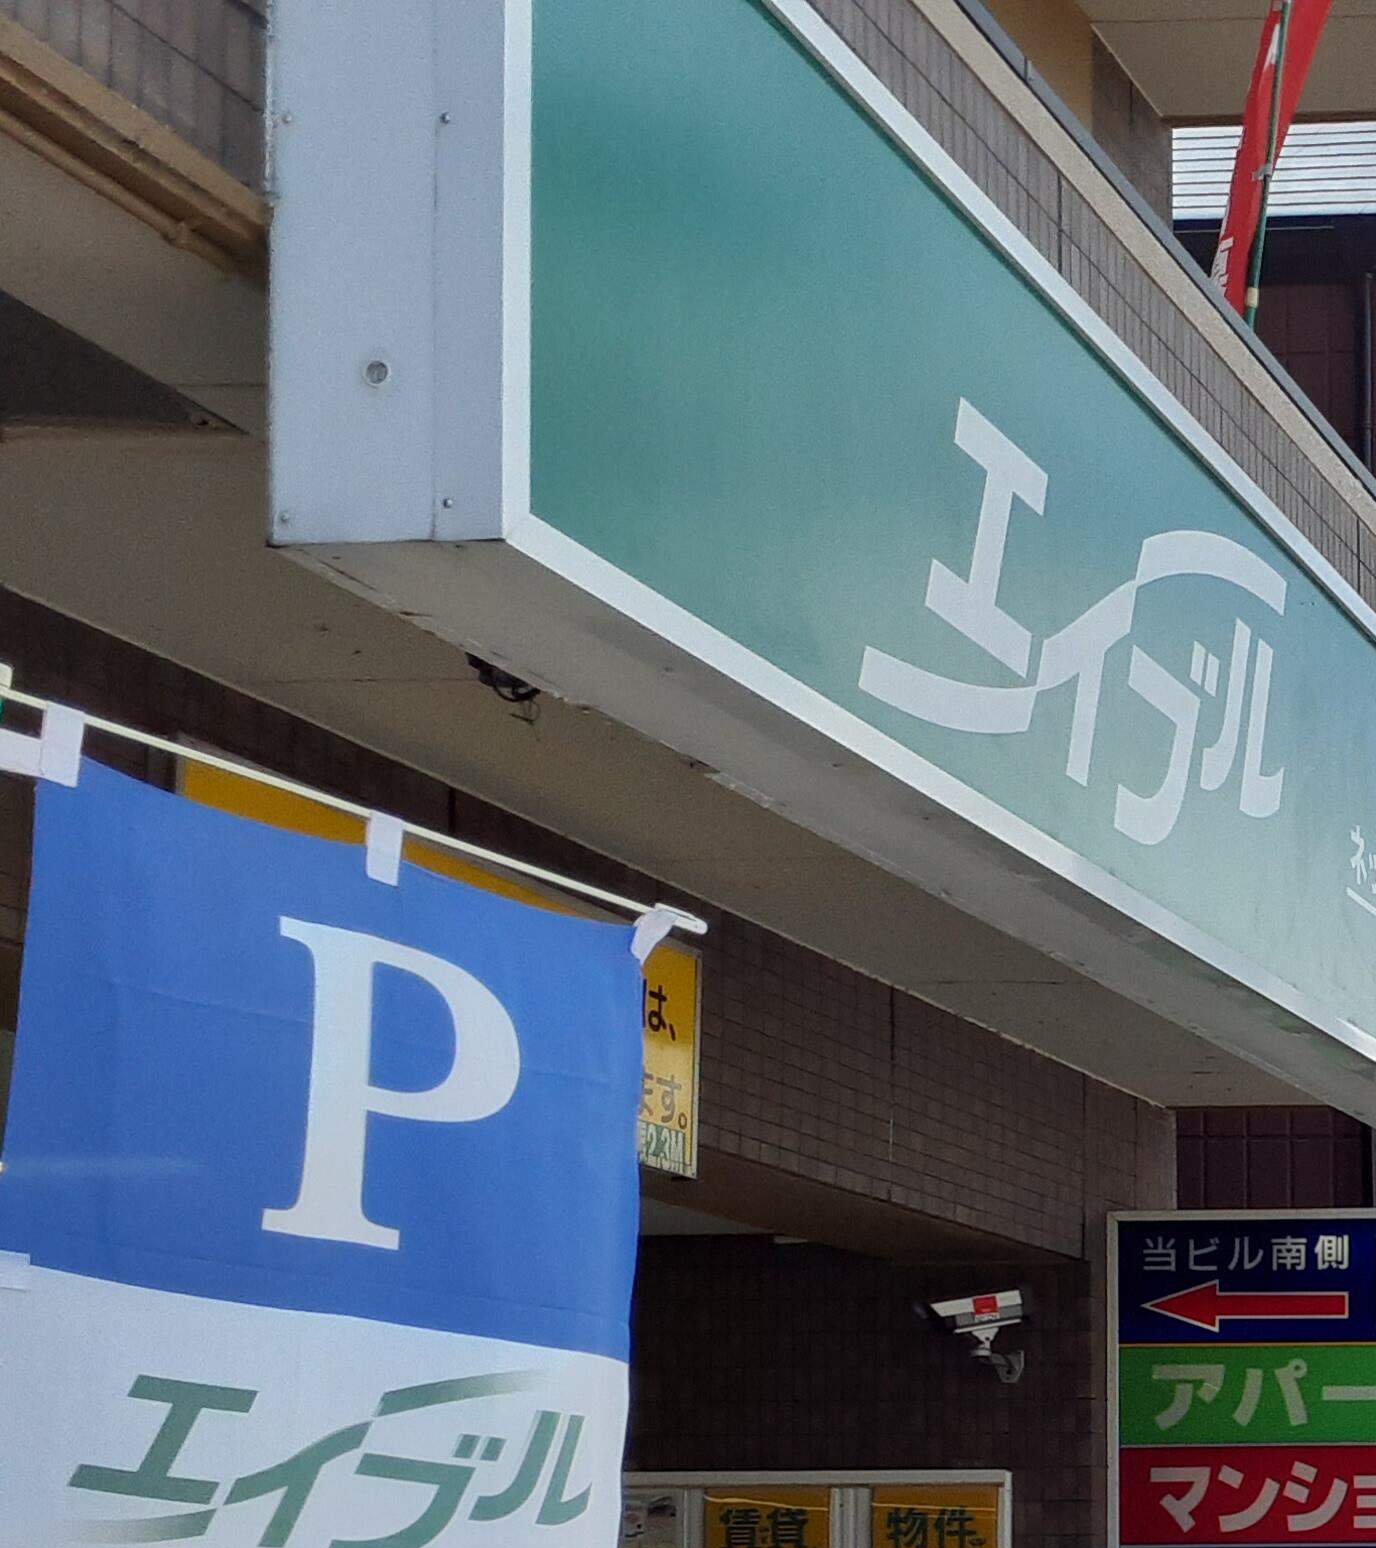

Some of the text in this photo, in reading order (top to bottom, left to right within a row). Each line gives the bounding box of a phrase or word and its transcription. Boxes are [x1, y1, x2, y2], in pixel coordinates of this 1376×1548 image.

[859, 397, 1287, 846] エイブル
[261, 915, 520, 1250] P
[1143, 1234, 1350, 1273] 当ビル南側
